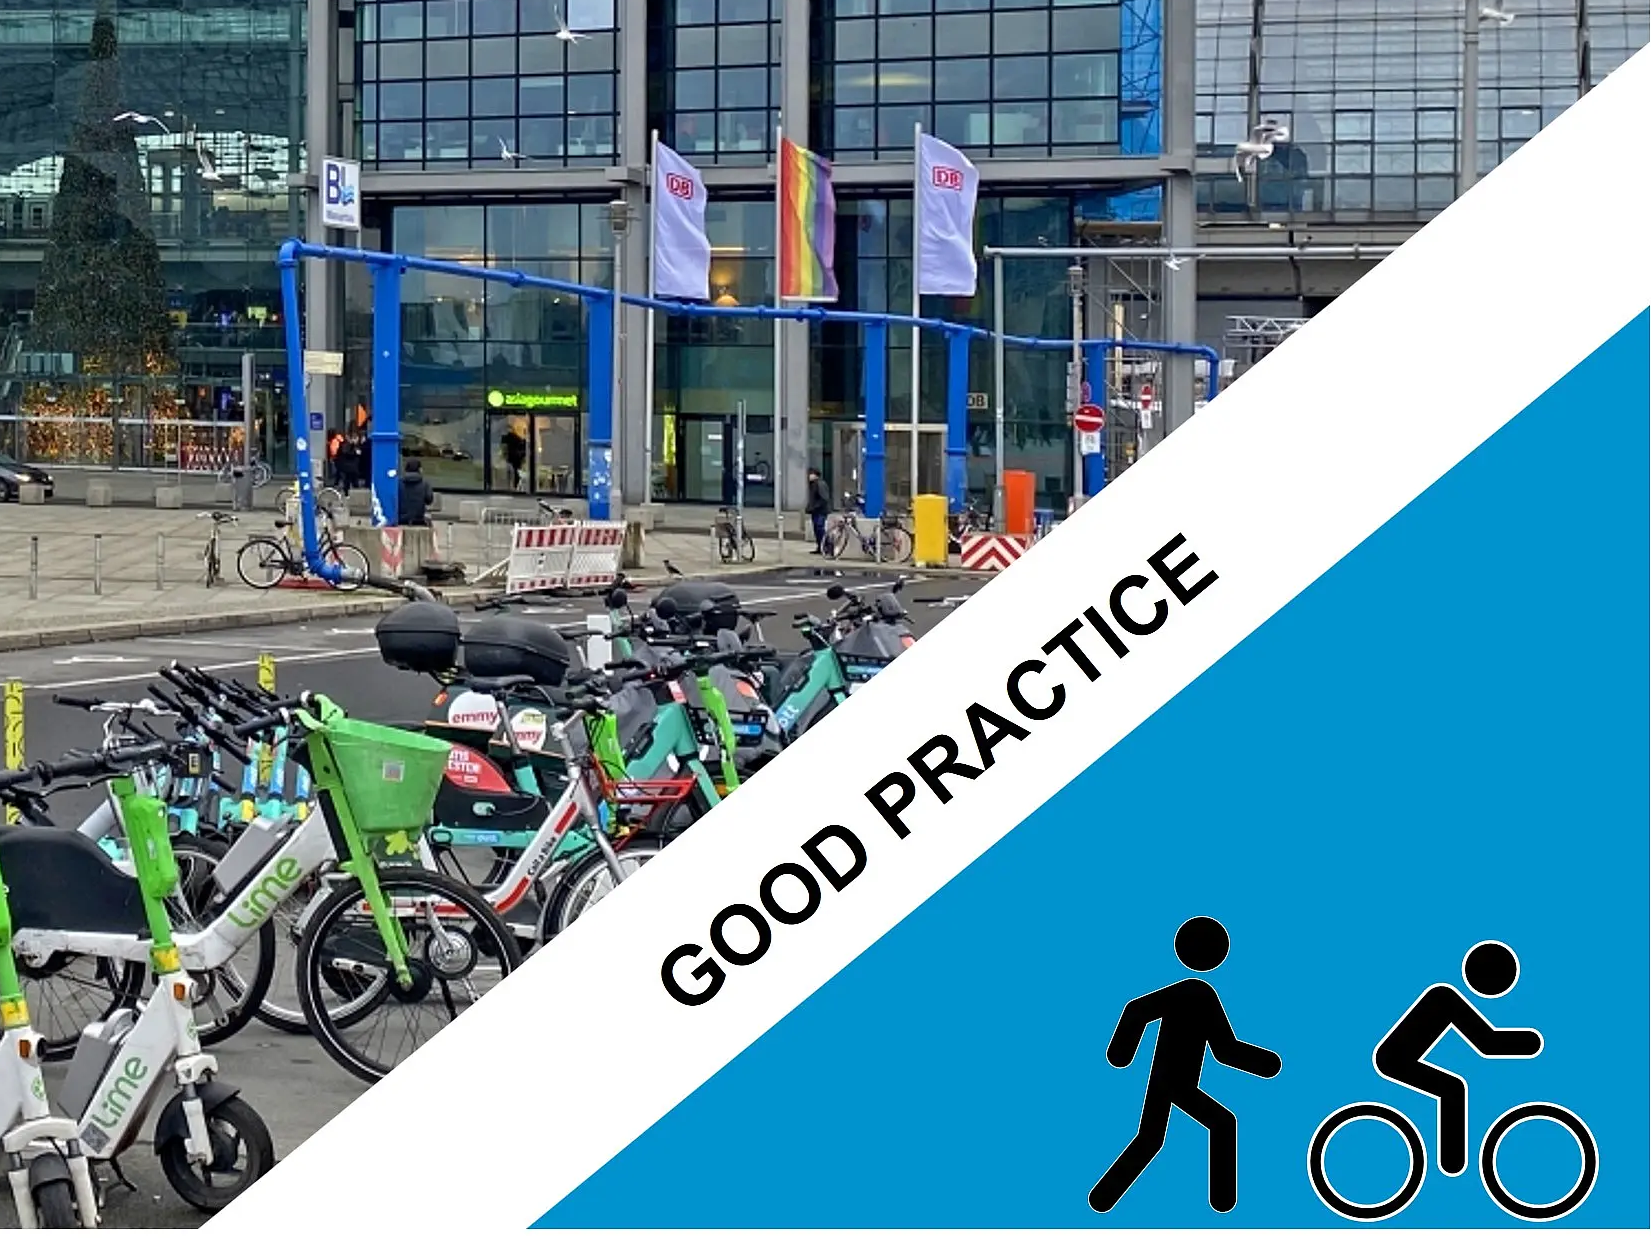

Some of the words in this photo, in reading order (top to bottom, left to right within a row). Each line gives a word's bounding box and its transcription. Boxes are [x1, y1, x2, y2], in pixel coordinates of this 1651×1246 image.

[670, 174, 690, 197] DB
[453, 711, 498, 725] emmy
[515, 730, 542, 745] mmy
[227, 857, 302, 928] Lime
[91, 1055, 148, 1129] Lime
